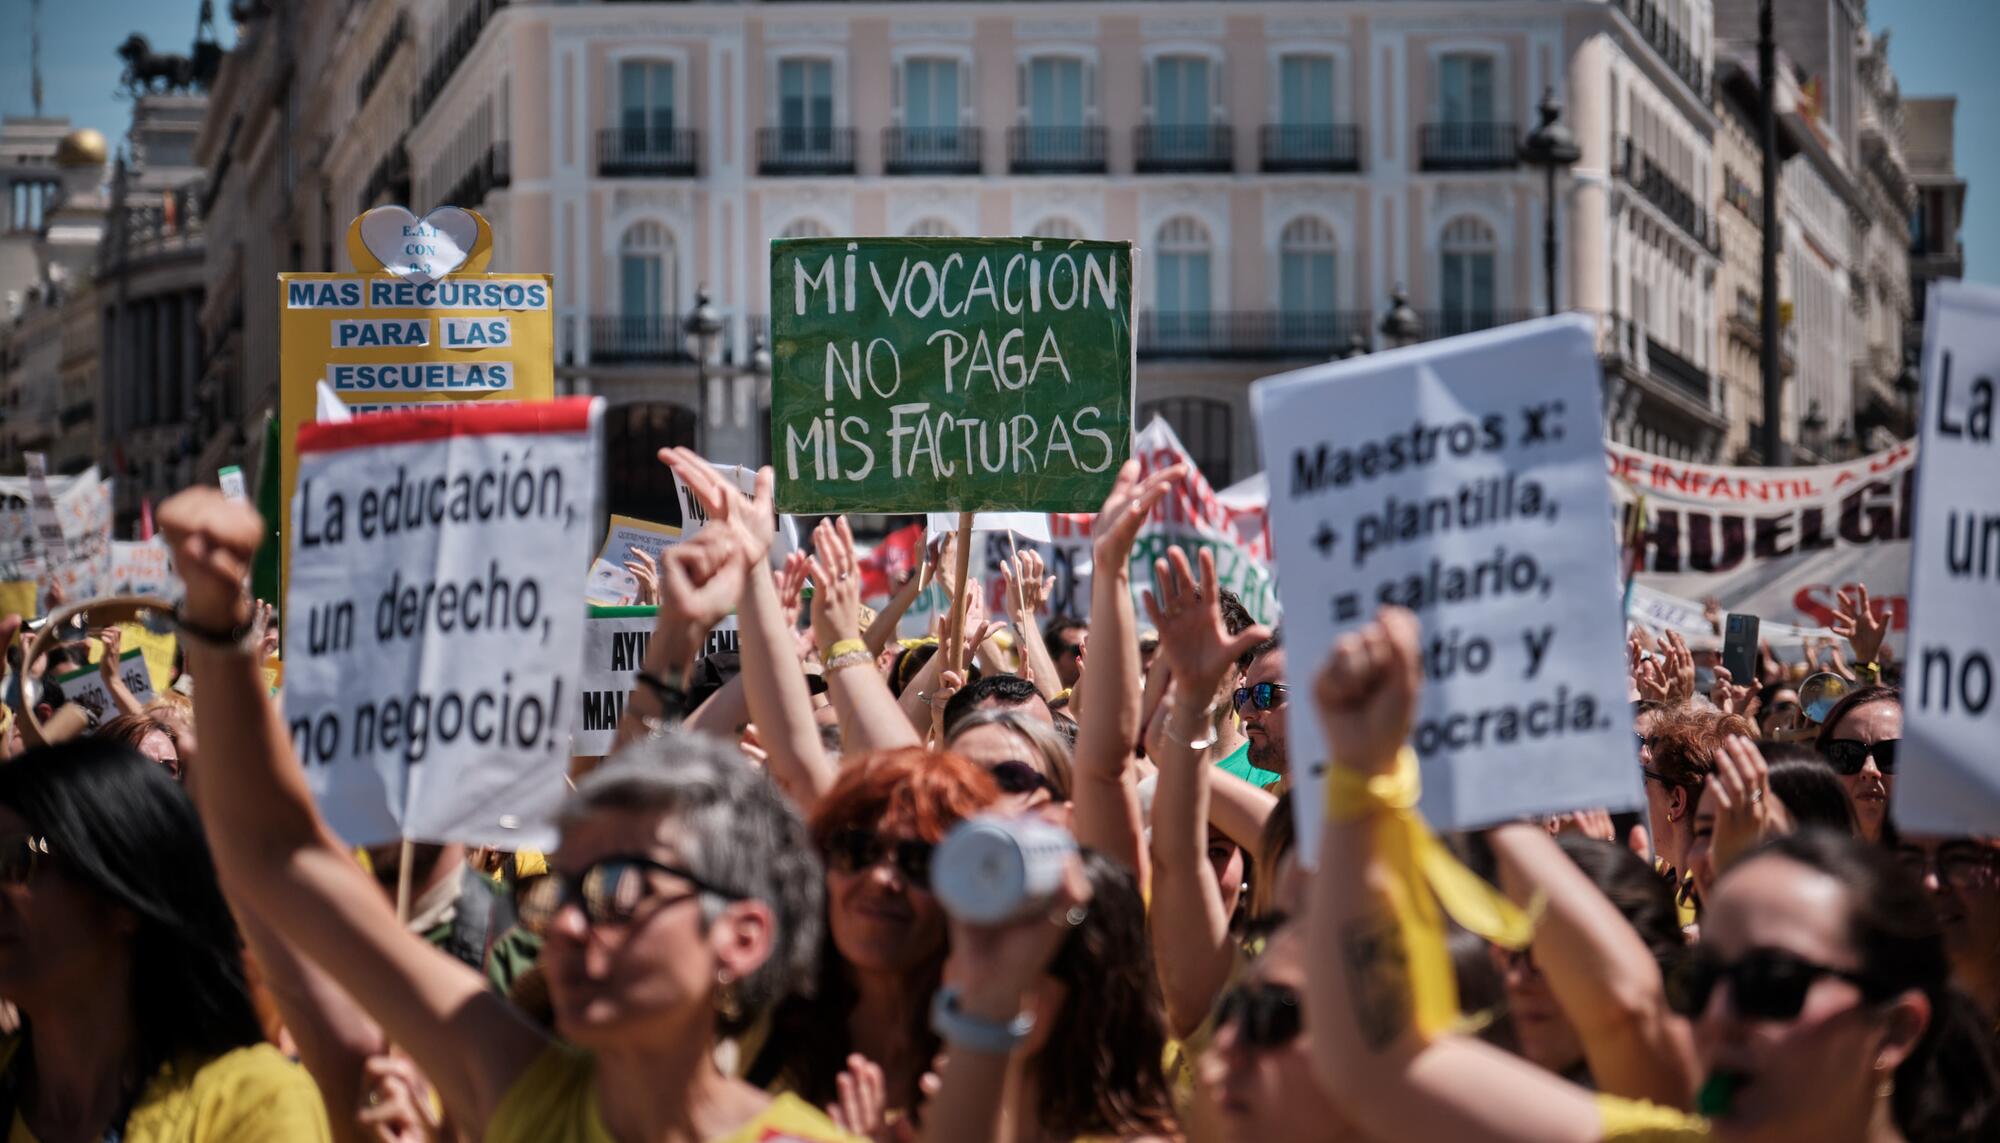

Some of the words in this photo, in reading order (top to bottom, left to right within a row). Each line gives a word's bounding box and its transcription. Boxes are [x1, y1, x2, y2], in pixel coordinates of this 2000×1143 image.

[406, 243, 435, 256] CON
[289, 283, 360, 306] MAS
[371, 283, 545, 306] RECURSOS
[339, 322, 426, 346] PARA
[448, 322, 507, 345] LAS
[825, 338, 900, 401] NO
[926, 326, 1071, 393] PAGA
[335, 364, 507, 389] ESCUELAS
[1938, 350, 1994, 443] La
[887, 402, 1113, 481] FACTURAS
[1291, 413, 1505, 498] Maestros
[1520, 400, 1566, 447] x:
[301, 477, 345, 547] La
[358, 447, 577, 540] educación,
[1650, 463, 1821, 502] INFANTIL
[1353, 473, 1560, 567] plantilla,
[1624, 472, 1912, 573] HUELG
[309, 600, 355, 656] un
[376, 560, 552, 643] derecho,
[1376, 546, 1553, 610] salario,
[1521, 625, 1554, 680] y
[1919, 648, 1993, 717] no
[290, 711, 341, 766] no
[353, 671, 565, 764] negocio!
[1414, 686, 1613, 758] ocracia.
